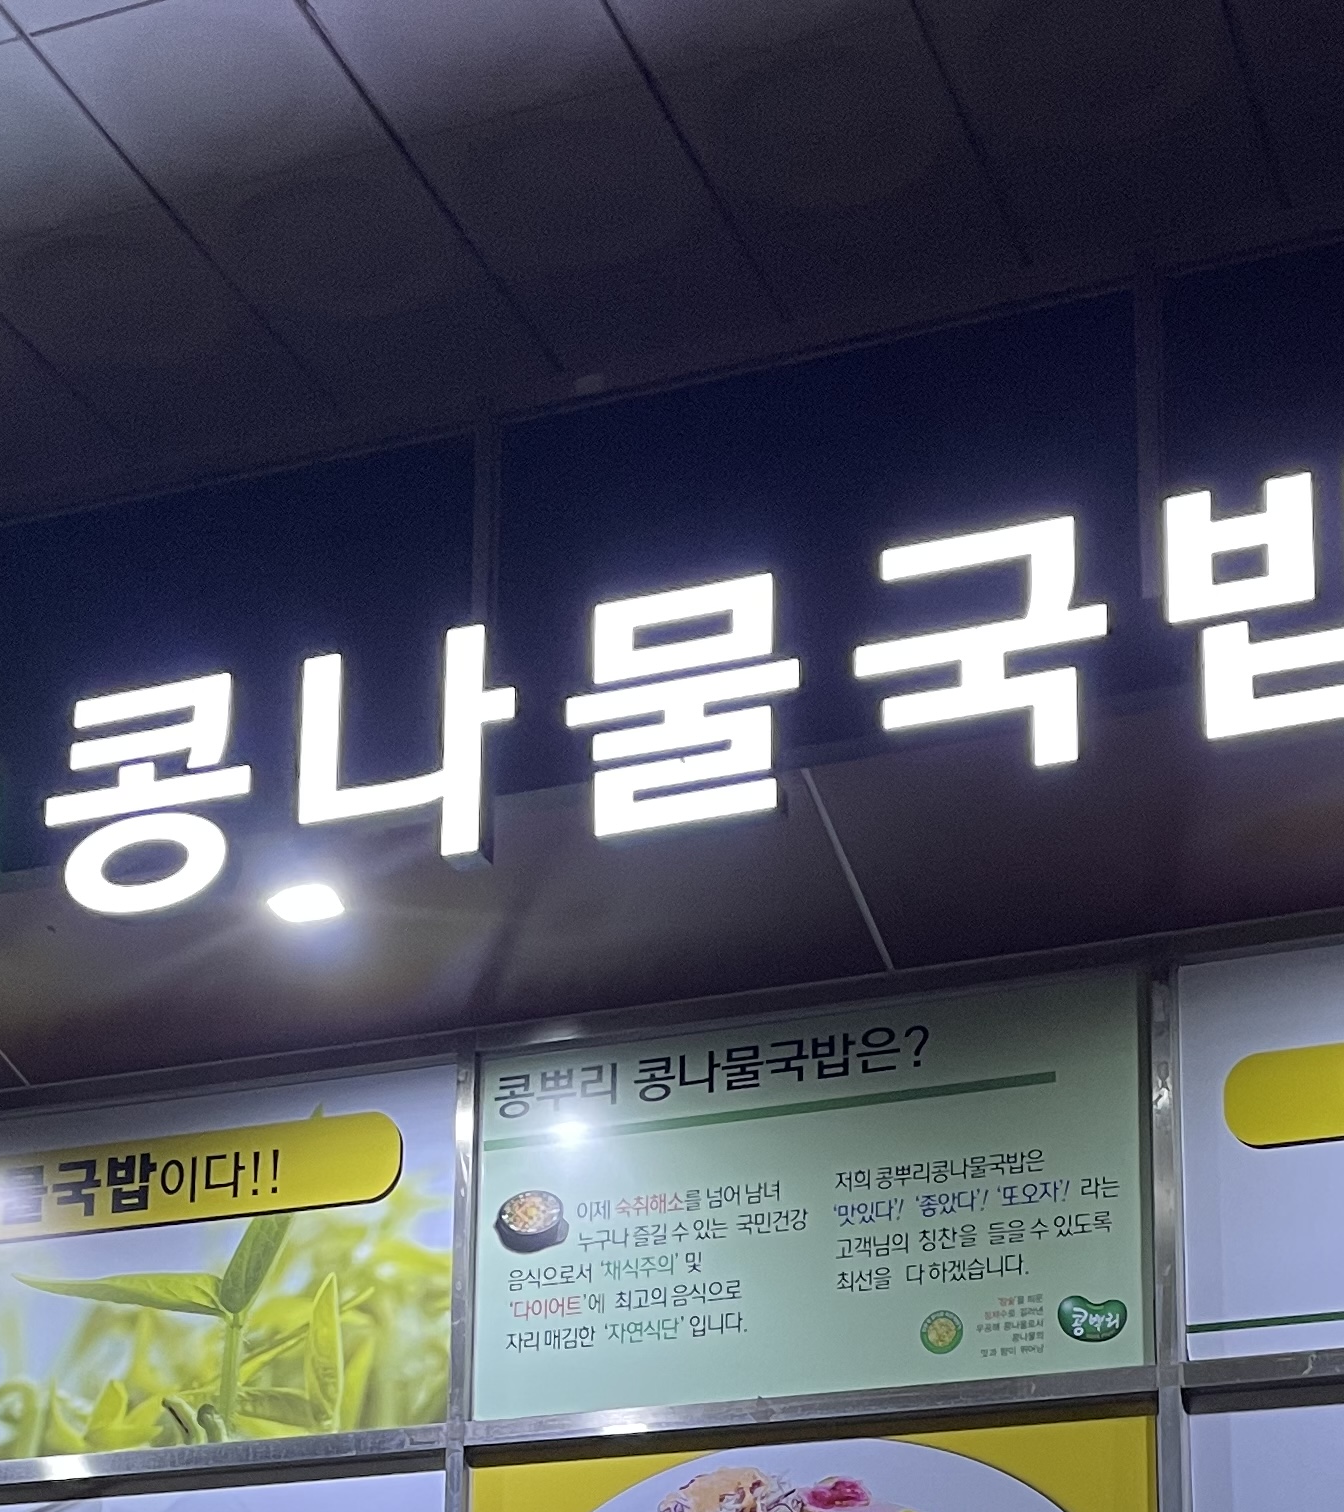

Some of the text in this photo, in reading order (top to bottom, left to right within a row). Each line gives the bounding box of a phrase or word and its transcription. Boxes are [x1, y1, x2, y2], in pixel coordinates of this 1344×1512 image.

[495, 1025, 931, 1119] 콩뿌리 콩나물국밥은?
[835, 1149, 1045, 1193] 저희 콩뿌리콩나물국밥은
[1080, 1176, 1121, 1200] 라는
[576, 1180, 781, 1222] 이제 숙취해소를 넘어 남녀
[577, 1208, 809, 1252] 누구나 즐길 수 있는 국민건강
[835, 1210, 1113, 1260] 고객님의 칭찬을 들을 수 있도록
[507, 1263, 593, 1292] 음식으로서
[685, 1252, 703, 1273] 및
[836, 1253, 1030, 1293] 최선을 다 하겠습니다.
[614, 1287, 668, 1312] 최고의
[671, 1280, 743, 1307] 음식으로
[689, 1311, 748, 1338] 입니다.
